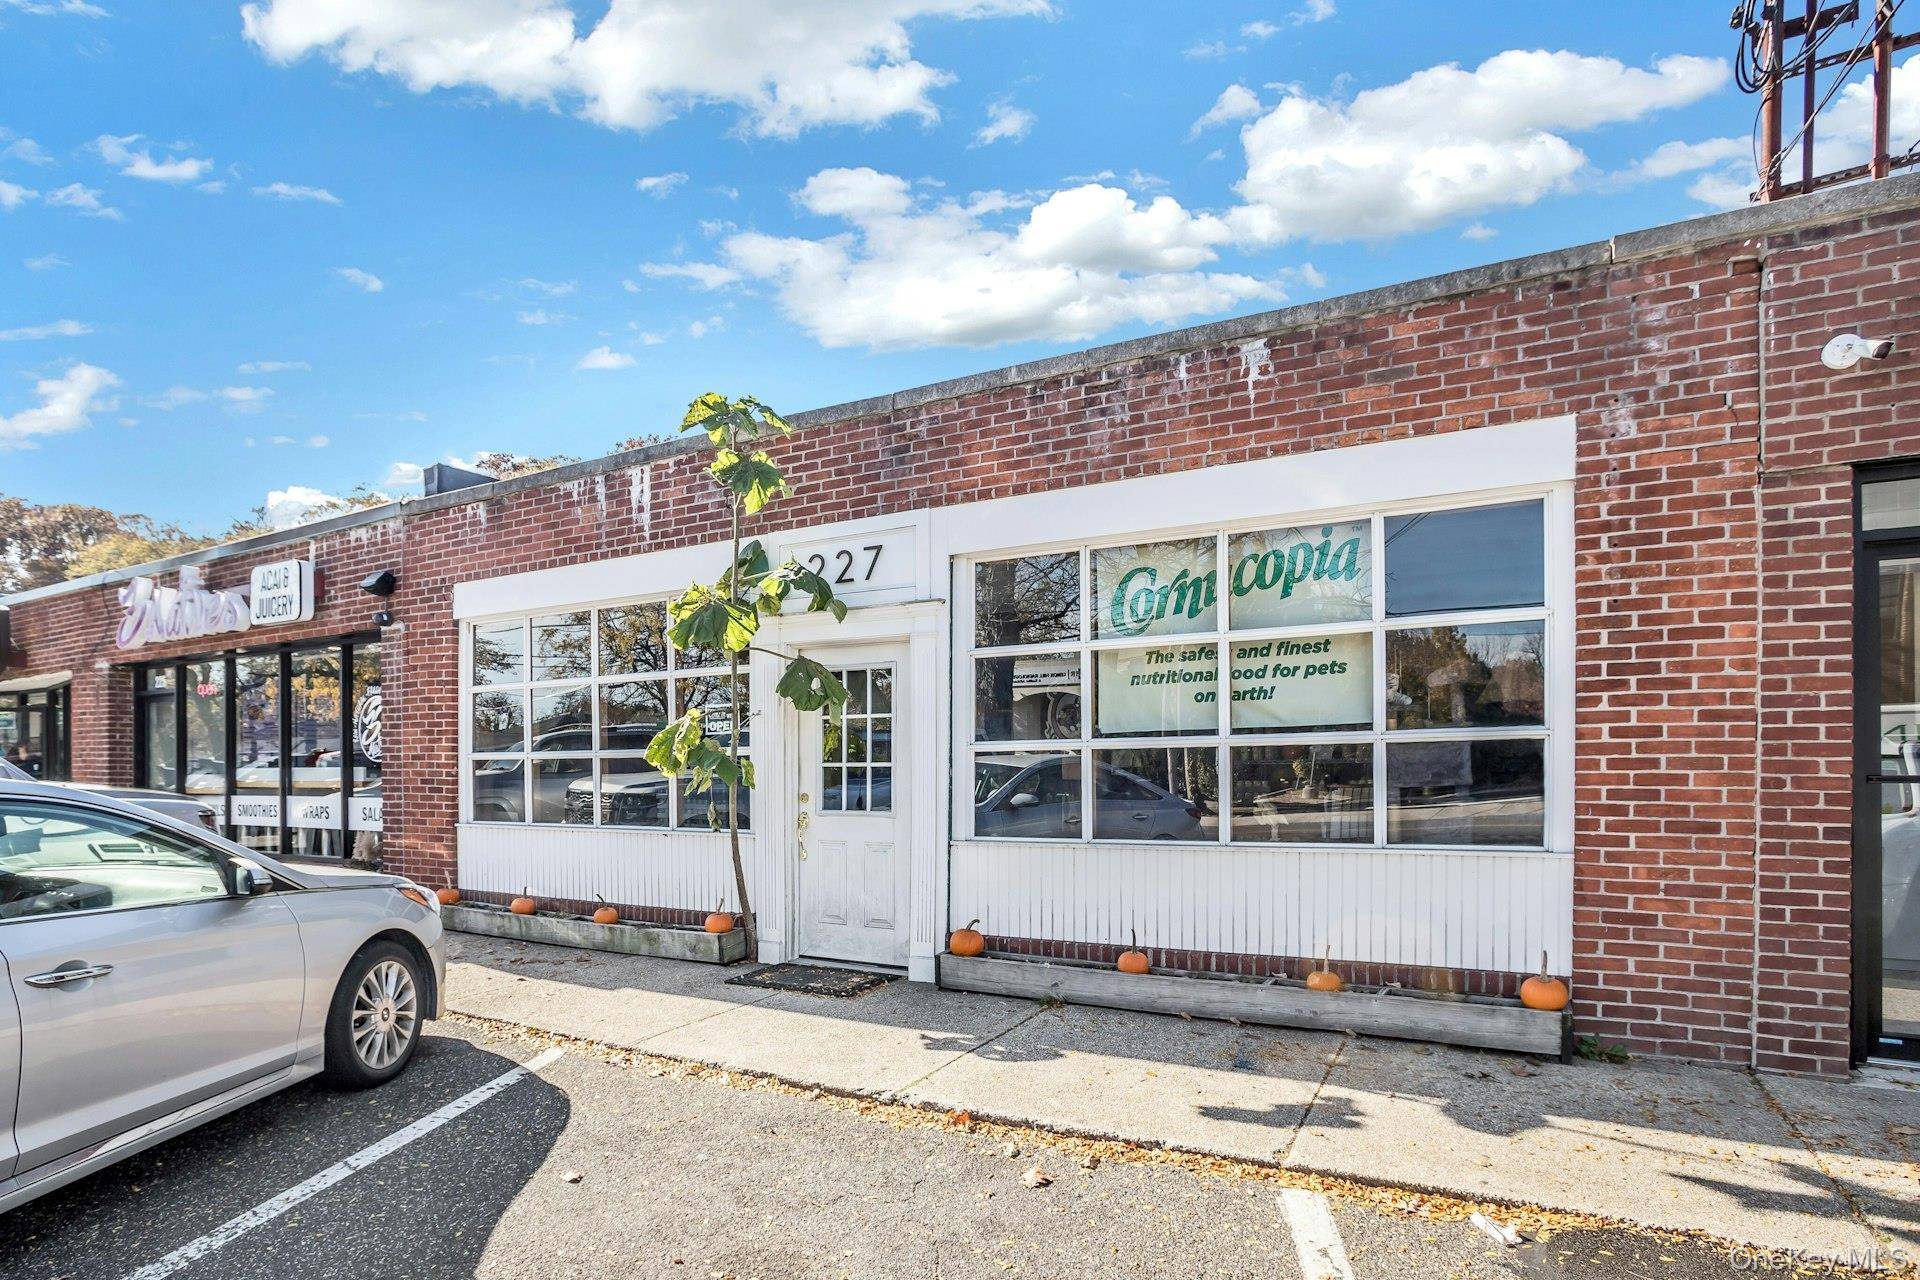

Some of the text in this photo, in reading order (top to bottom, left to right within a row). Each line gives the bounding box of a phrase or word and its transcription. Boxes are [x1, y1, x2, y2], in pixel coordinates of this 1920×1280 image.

[808, 544, 883, 584] 227
[260, 567, 289, 593] ACAI &
[1110, 527, 1363, 637] Cornucopia
[255, 594, 295, 619] JUICERY
[1145, 638, 1332, 665] The safes and finest
[1130, 659, 1348, 687] nutritional ood for pets
[1193, 685, 1276, 703] on arth!
[237, 804, 278, 819] SMOOTHIES
